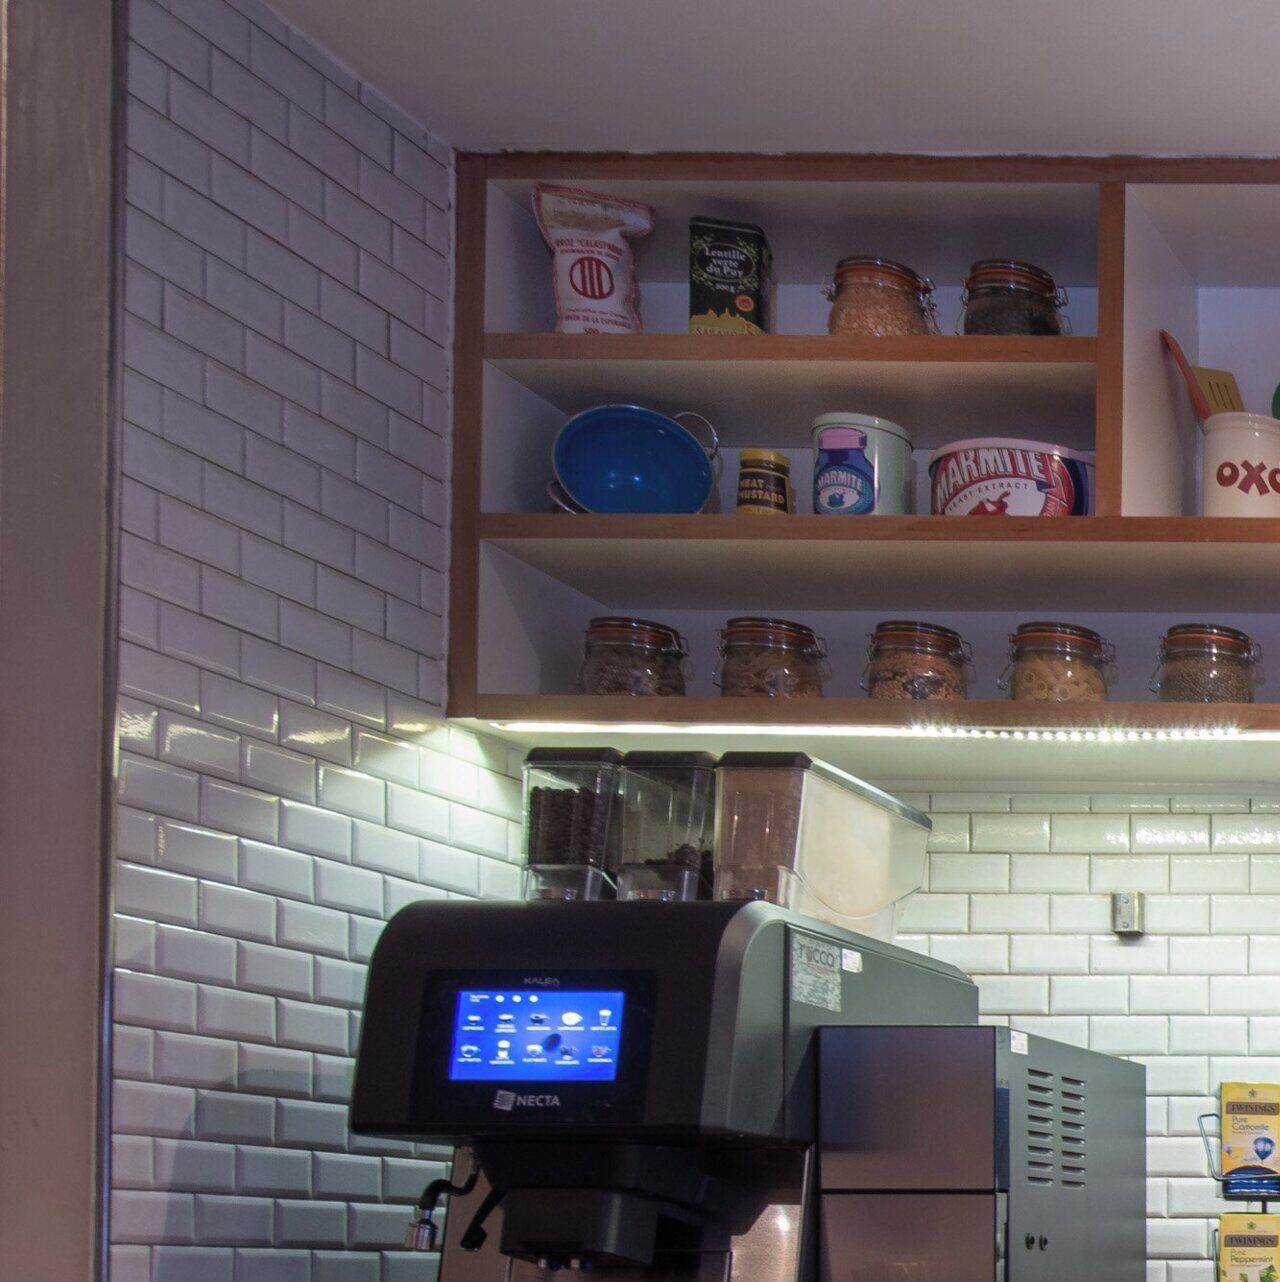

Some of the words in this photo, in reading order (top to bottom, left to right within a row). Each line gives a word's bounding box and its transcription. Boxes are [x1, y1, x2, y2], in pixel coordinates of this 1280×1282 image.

[705, 247, 747, 261] Lentille
[712, 258, 739, 268] verte
[706, 264, 721, 275] du
[723, 266, 744, 279] Puy
[817, 470, 864, 491] MARMITE
[936, 448, 1048, 515] MARMITE
[977, 481, 1028, 493] EXTRACT
[515, 1095, 561, 1107] NECTA
[1232, 1104, 1275, 1113] TWININGS
[1230, 1236, 1274, 1245] TWININGS
[1230, 1256, 1274, 1265] Peppermint
